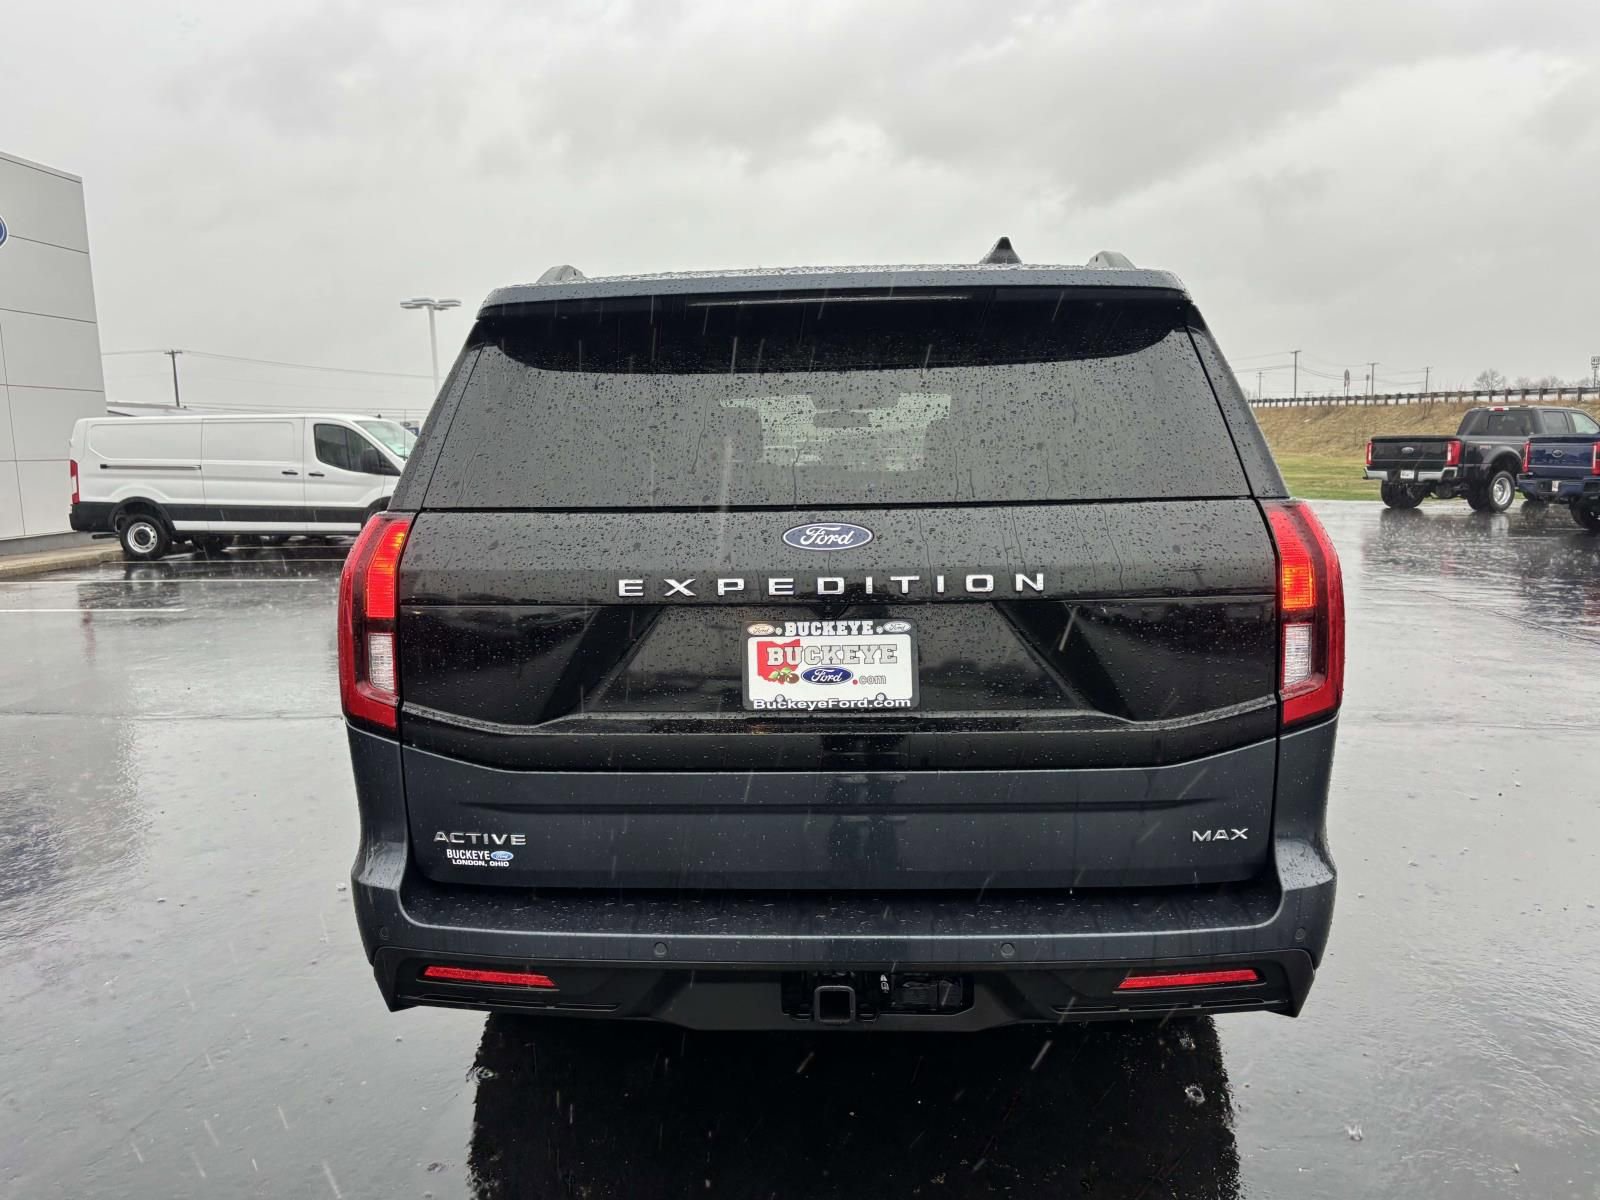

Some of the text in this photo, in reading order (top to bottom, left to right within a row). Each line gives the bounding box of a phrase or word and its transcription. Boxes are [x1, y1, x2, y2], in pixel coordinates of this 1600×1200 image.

[800, 526, 855, 545] Ford
[617, 573, 1045, 598] EXPEDITION
[784, 621, 874, 637] BUCKEYE
[766, 644, 898, 667] BUCKEYE
[811, 668, 843, 682] Ford
[753, 698, 911, 711] BuckeyeFord.com
[433, 831, 527, 846] ACTIVE
[1192, 828, 1249, 842] MAX
[446, 848, 491, 861] BUCKEYE
[452, 858, 488, 867] LONDON,
